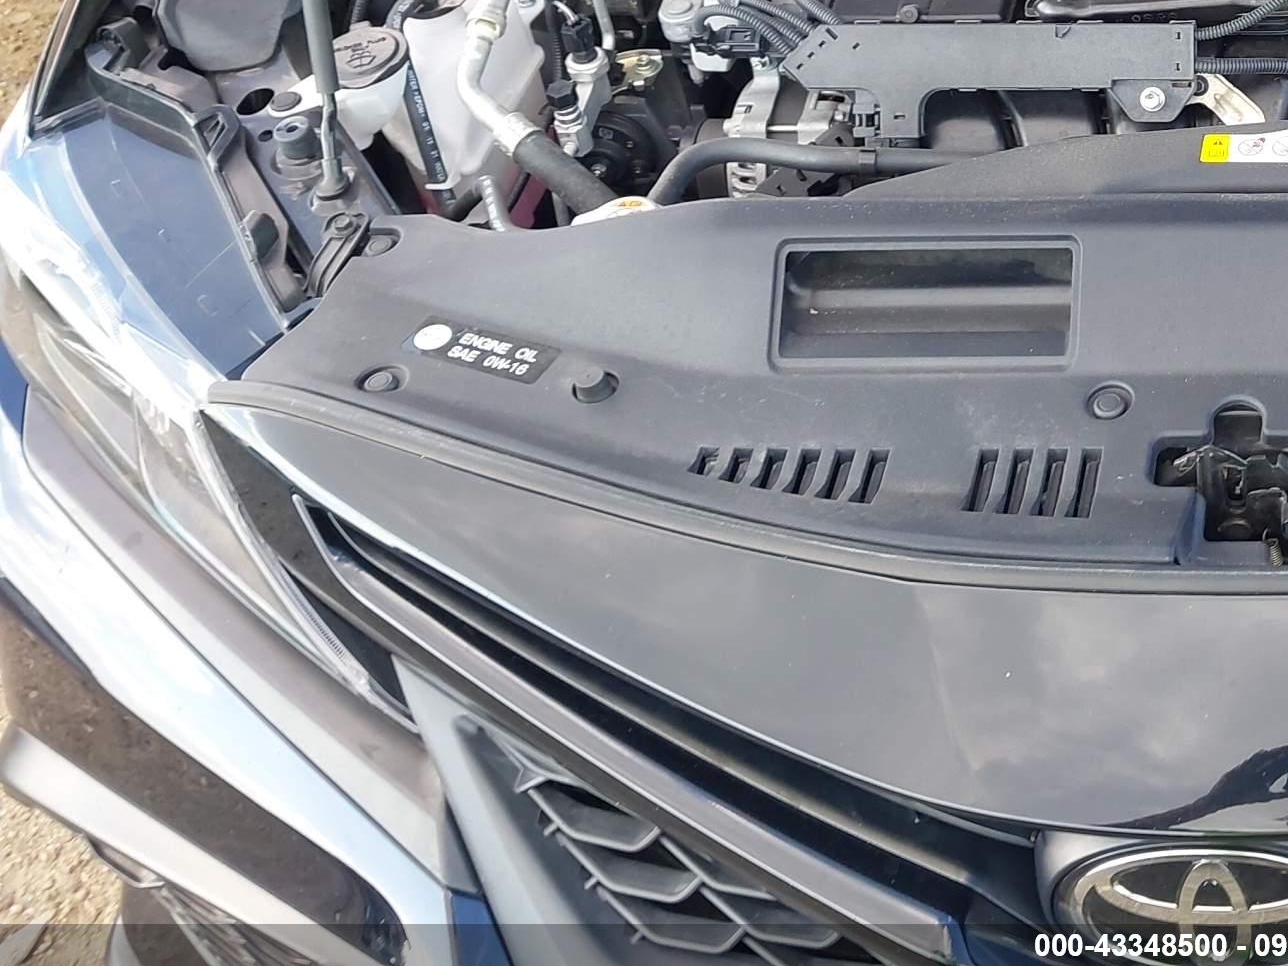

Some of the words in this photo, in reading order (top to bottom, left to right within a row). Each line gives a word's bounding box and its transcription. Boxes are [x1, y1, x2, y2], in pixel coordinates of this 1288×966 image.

[447, 345, 481, 362] SAE
[482, 355, 530, 375] 0W-16
[458, 332, 513, 355] ENGINE
[514, 347, 538, 363] OIL
